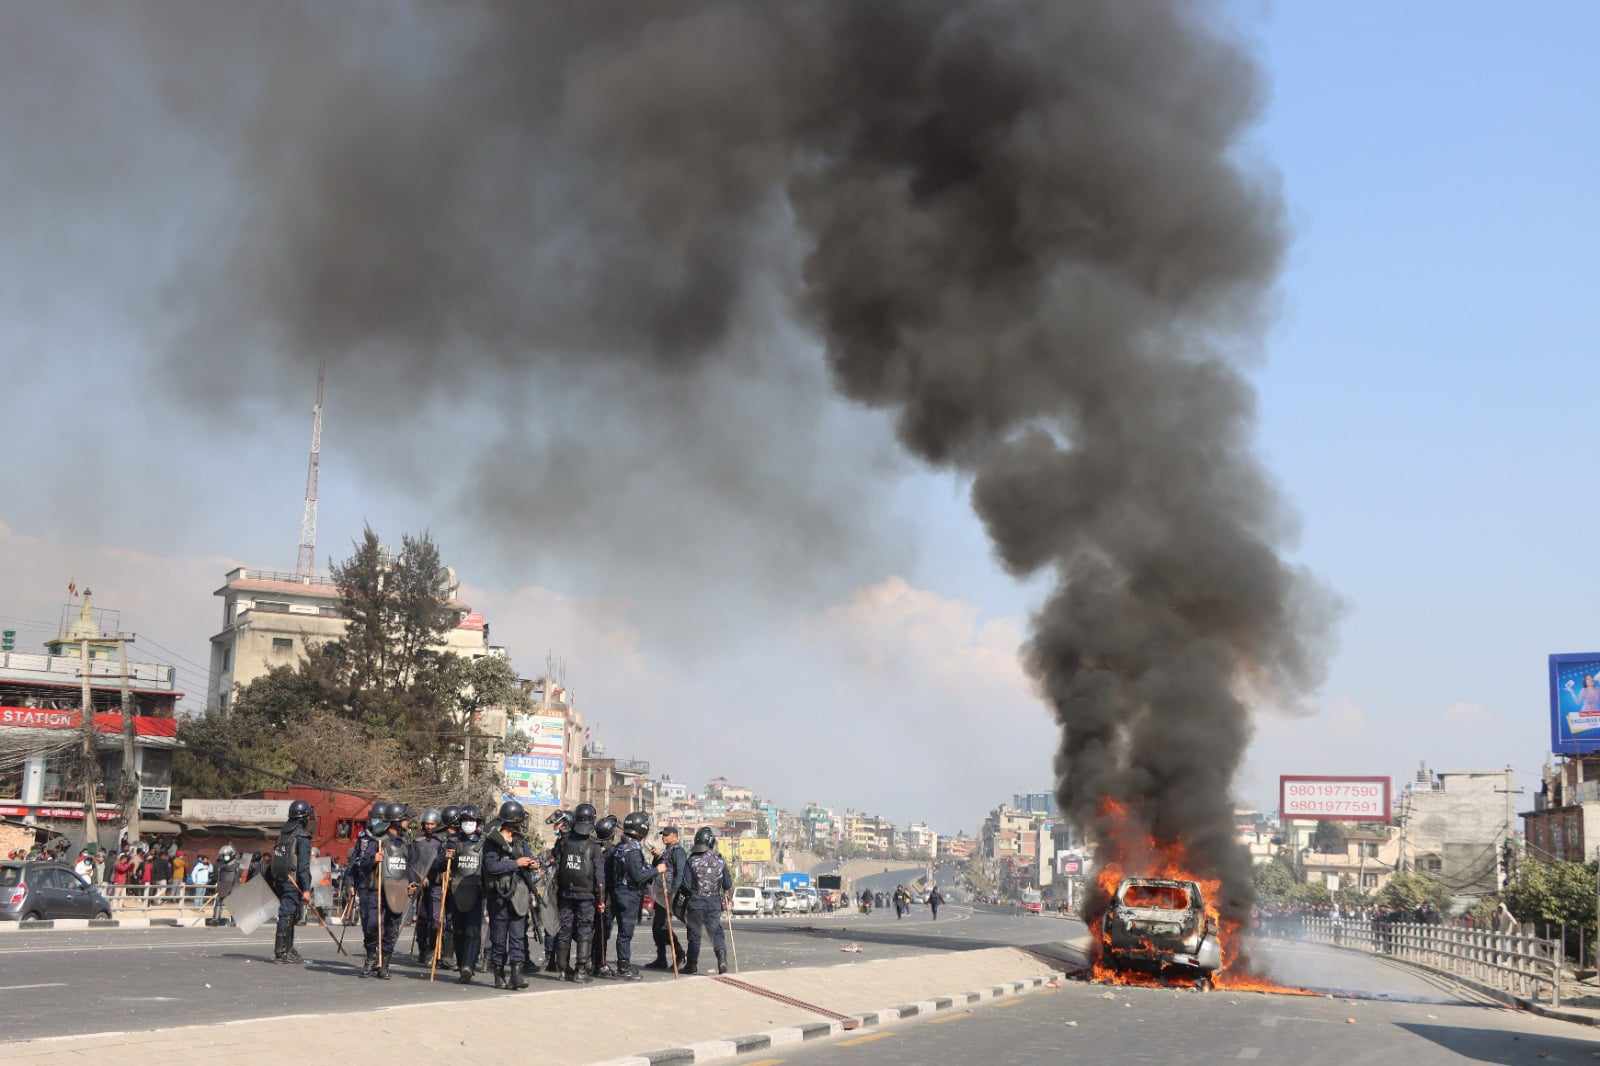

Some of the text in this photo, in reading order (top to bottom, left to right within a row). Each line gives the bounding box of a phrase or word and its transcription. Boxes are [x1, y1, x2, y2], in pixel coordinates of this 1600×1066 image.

[3, 711, 70, 725] STATION
[1289, 785, 1378, 797] 9801977590
[1290, 800, 1378, 812] 9801977591
[458, 855, 479, 863] NEPAL
